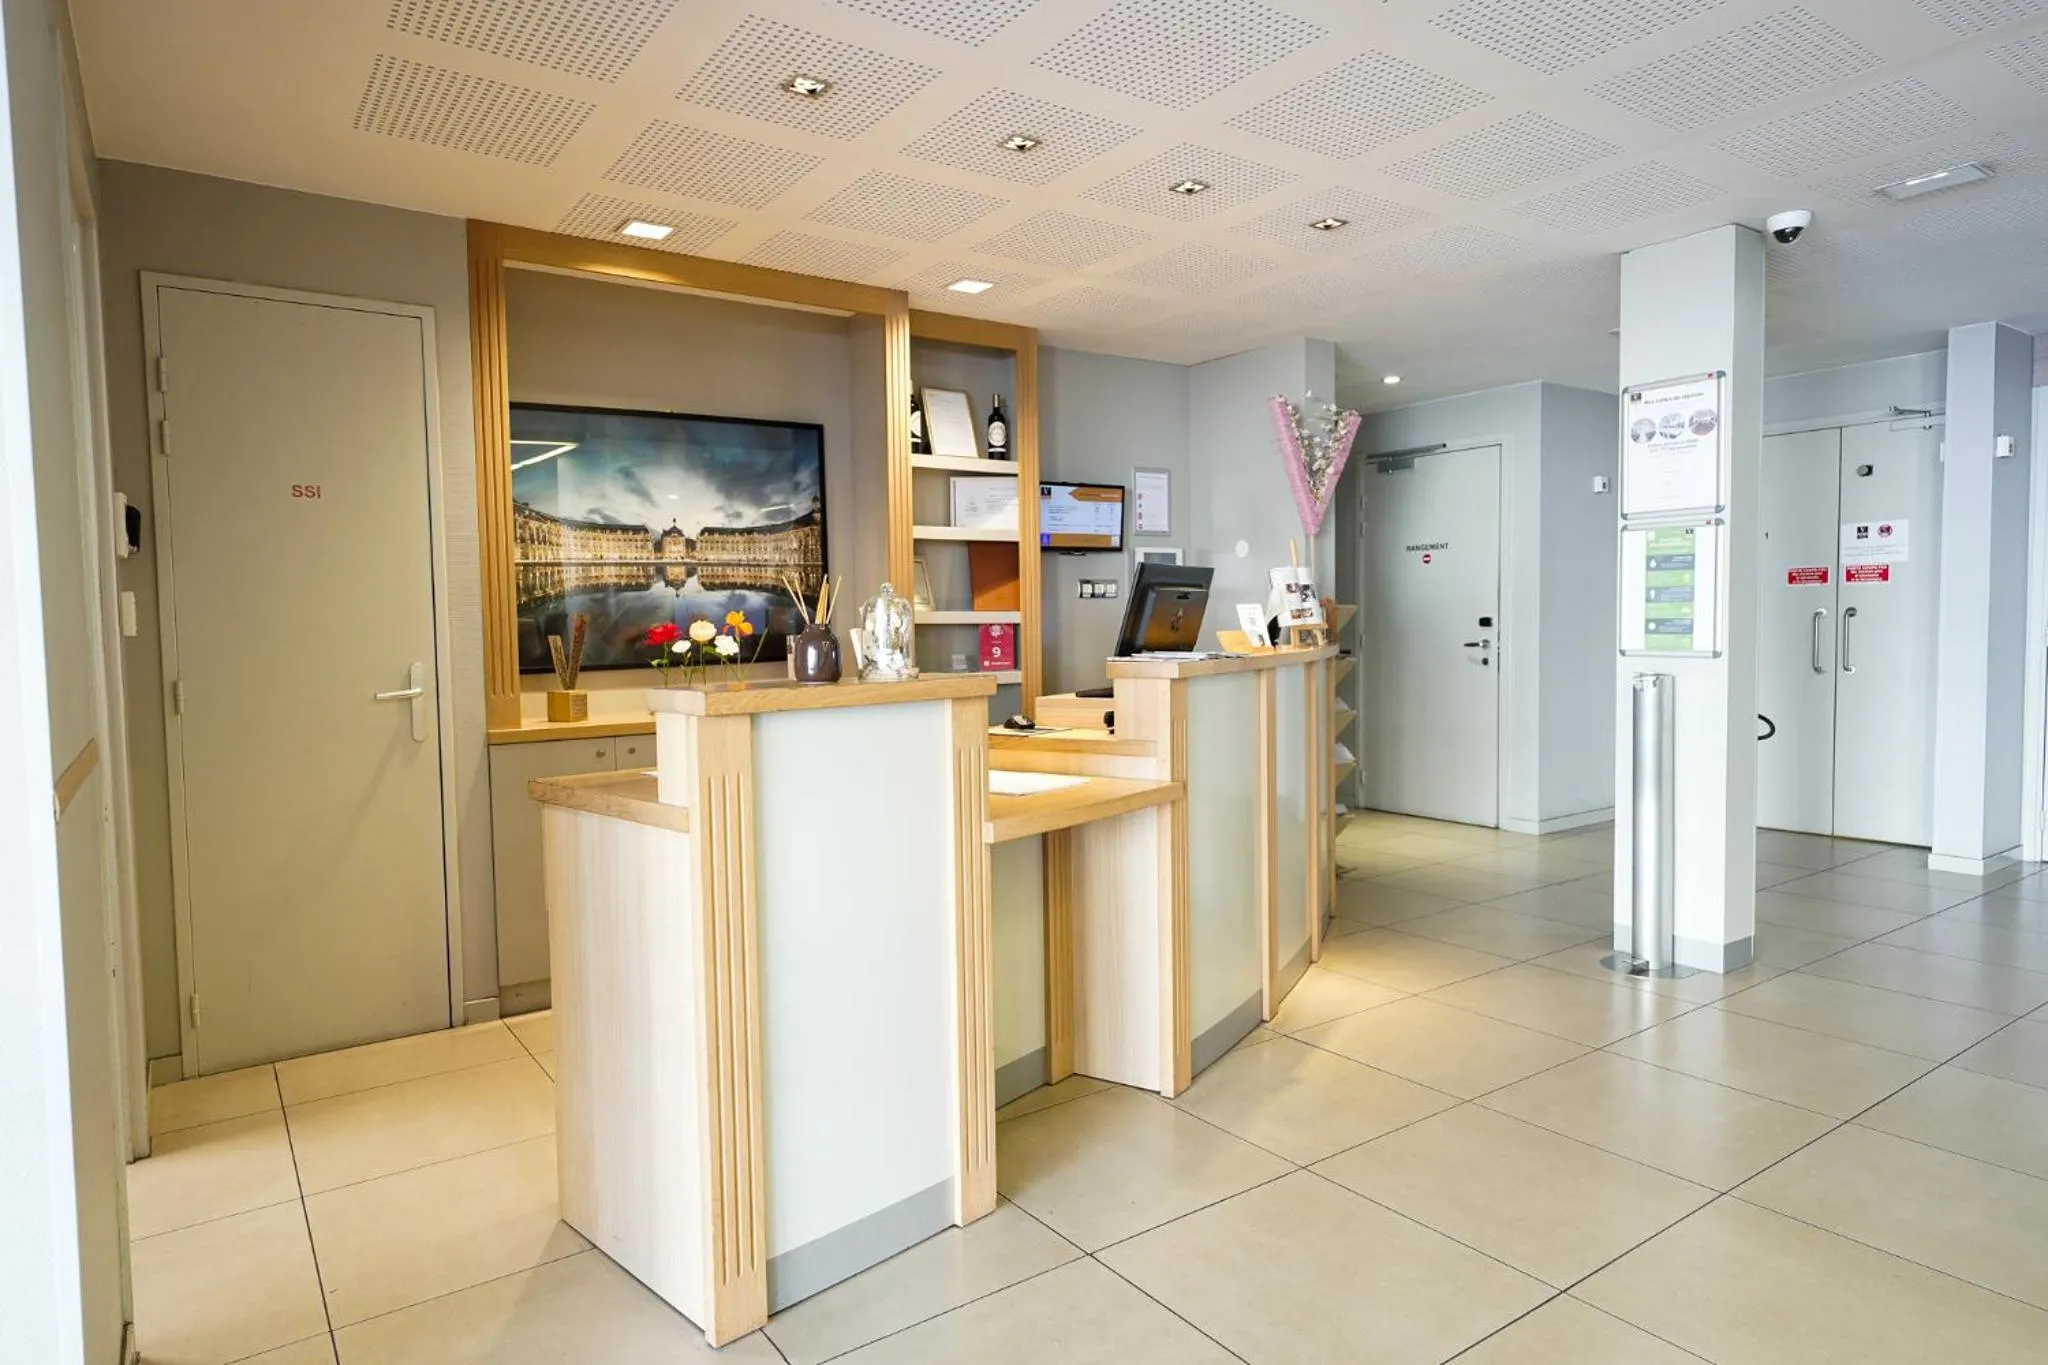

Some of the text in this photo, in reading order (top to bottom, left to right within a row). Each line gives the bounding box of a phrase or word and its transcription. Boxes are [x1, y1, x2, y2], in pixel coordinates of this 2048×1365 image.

[291, 484, 321, 500] SSI
[1406, 542, 1449, 551] RANGEMENT
[992, 646, 1001, 658] 9
